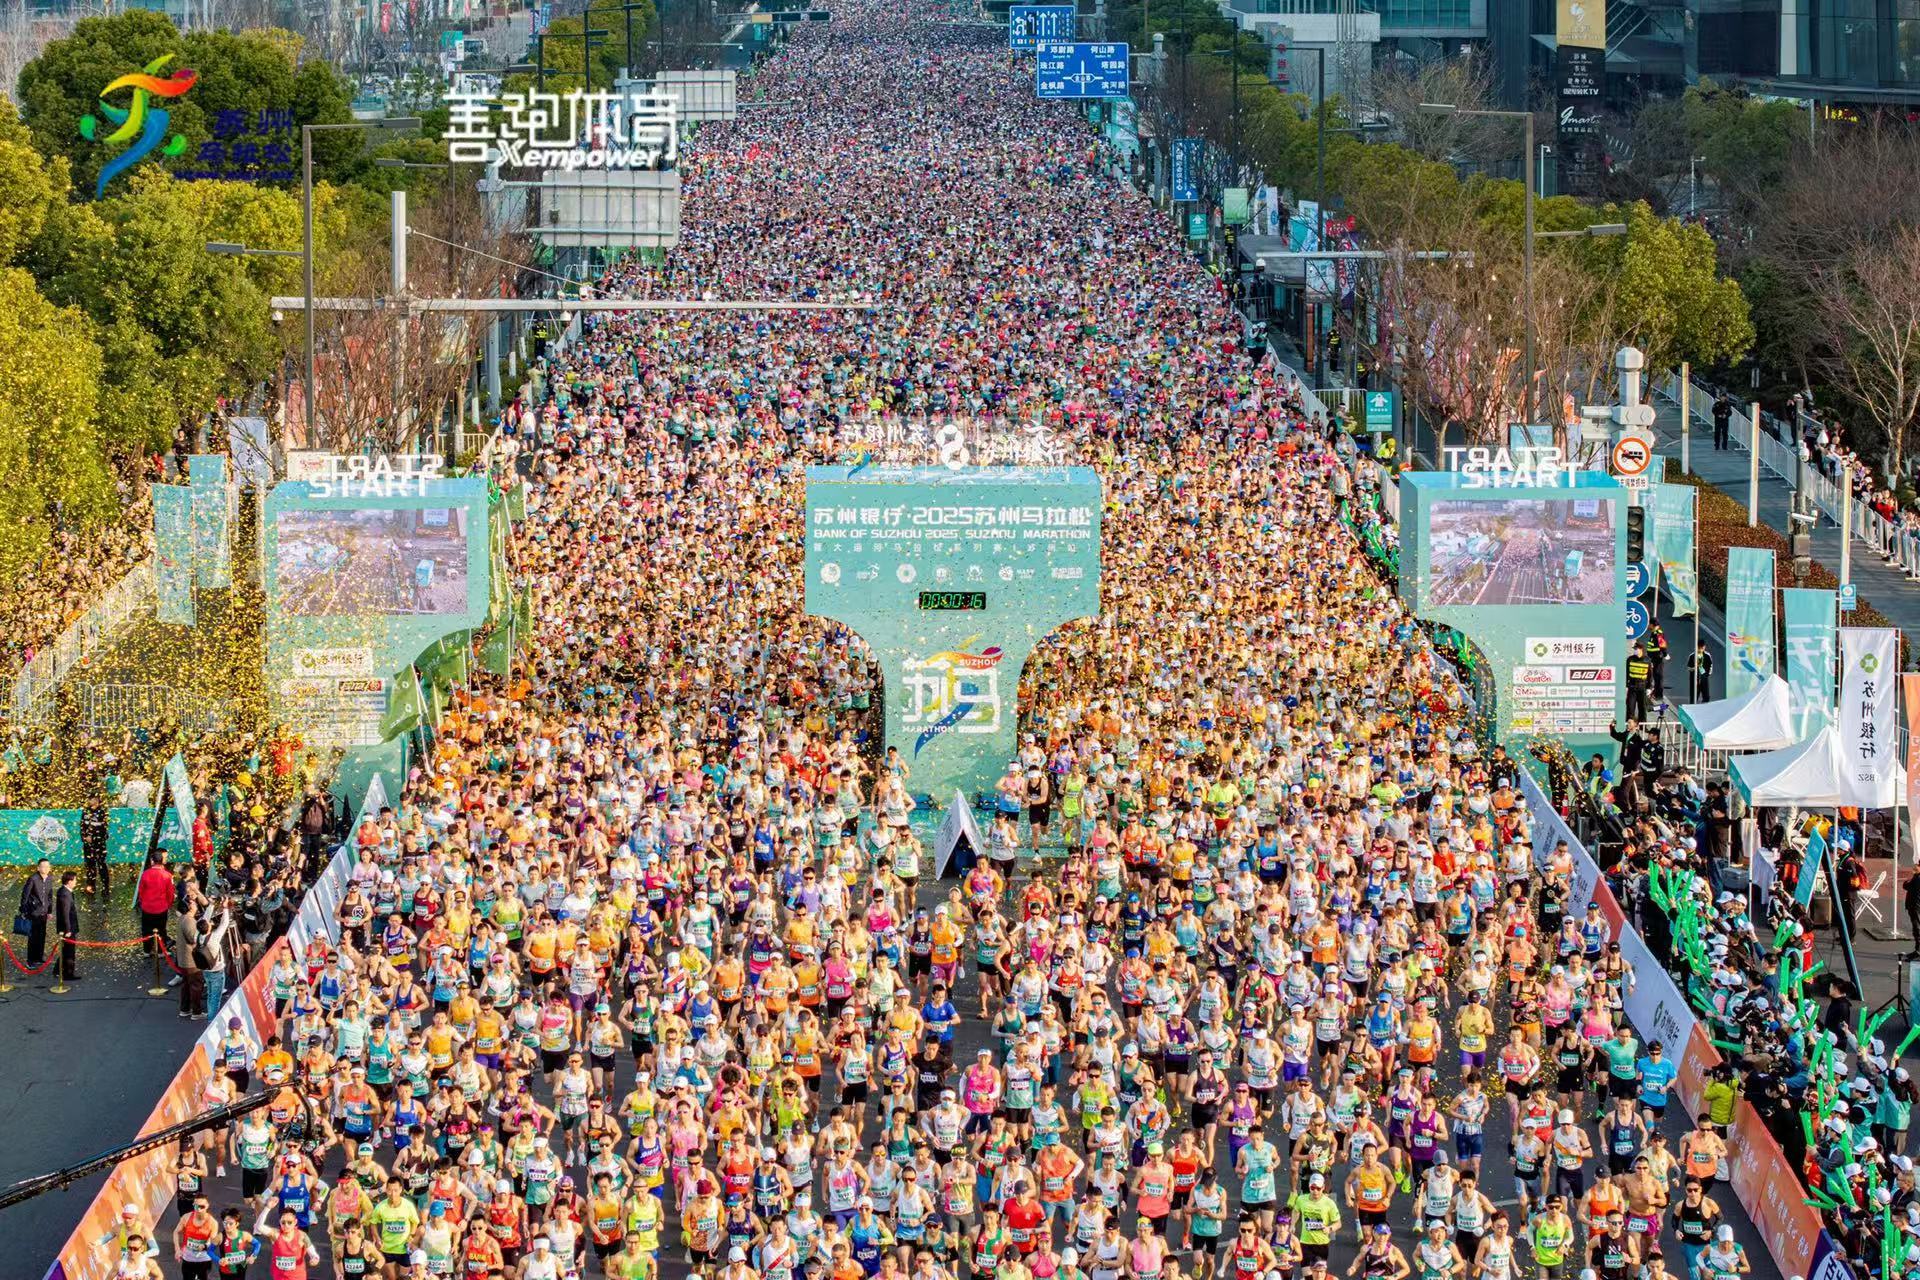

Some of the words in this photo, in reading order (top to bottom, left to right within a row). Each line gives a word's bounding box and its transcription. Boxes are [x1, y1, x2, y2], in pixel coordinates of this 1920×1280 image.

[1040, 61, 1065, 70] 珠江路
[1040, 81, 1065, 90] 金枫路
[1461, 462, 1584, 489] START
[308, 472, 431, 498] START
[813, 529, 847, 539] BANK
[850, 529, 867, 539] OF
[871, 529, 922, 539] SUZHOU
[925, 529, 959, 539] 2025
[965, 529, 1016, 539] SUZHOU
[1023, 529, 1091, 539] MARATHON
[1552, 643, 1596, 654] 苏州银行
[959, 658, 997, 666] SUZHOU
[902, 725, 955, 734] MARATHON
